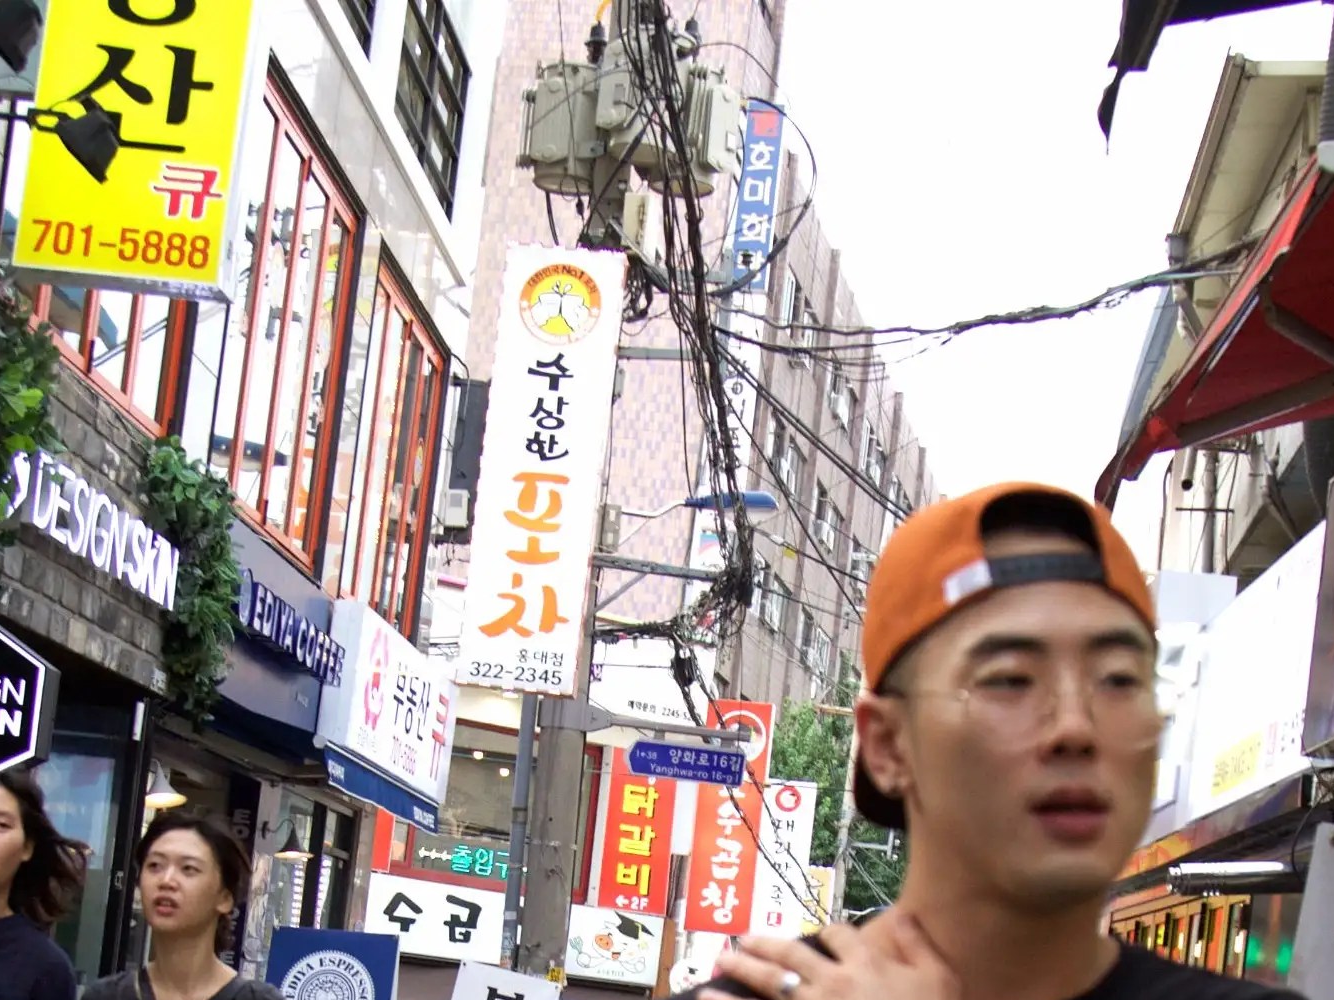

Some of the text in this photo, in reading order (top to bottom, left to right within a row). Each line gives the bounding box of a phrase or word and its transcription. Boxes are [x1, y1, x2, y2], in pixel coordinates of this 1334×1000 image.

[153, 163, 223, 220] 큐
[31, 218, 211, 270] 701-5888
[525, 352, 573, 461] 수상한
[32, 452, 130, 580] DESIGN
[124, 519, 180, 612] SKIN
[478, 471, 570, 639] 포차
[253, 581, 346, 689] EDIYA COFFEE
[516, 649, 564, 667] 홍대점
[469, 660, 562, 687] 322-2345
[393, 674, 450, 782] 부동산 큐
[650, 763, 708, 779] Yanghwa-ro
[669, 748, 741, 773] 양화로16길
[616, 783, 659, 897] 닭갈비
[700, 786, 745, 924] 수곱창
[631, 896, 649, 911] 2F
[286, 963, 315, 1000] EDIYA
